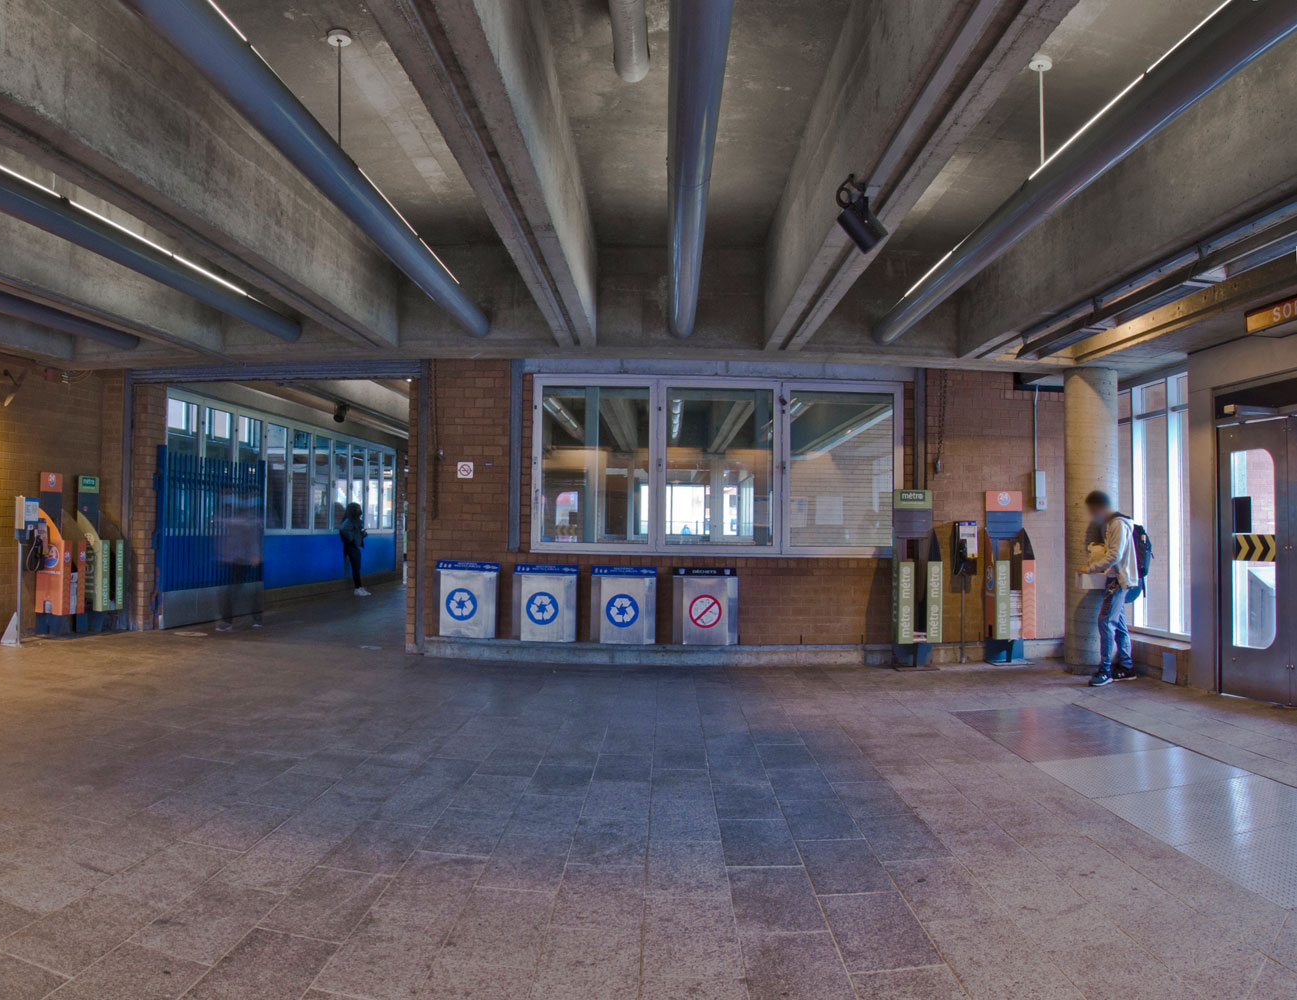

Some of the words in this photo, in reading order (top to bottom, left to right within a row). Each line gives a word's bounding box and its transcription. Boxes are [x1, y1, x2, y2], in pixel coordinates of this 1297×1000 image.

[902, 492, 924, 500] métro
[902, 566, 910, 599] métro
[930, 565, 940, 598] métro
[998, 564, 1007, 596] métro
[902, 605, 910, 638] métro
[929, 604, 938, 637] métro
[998, 602, 1007, 634] métro
